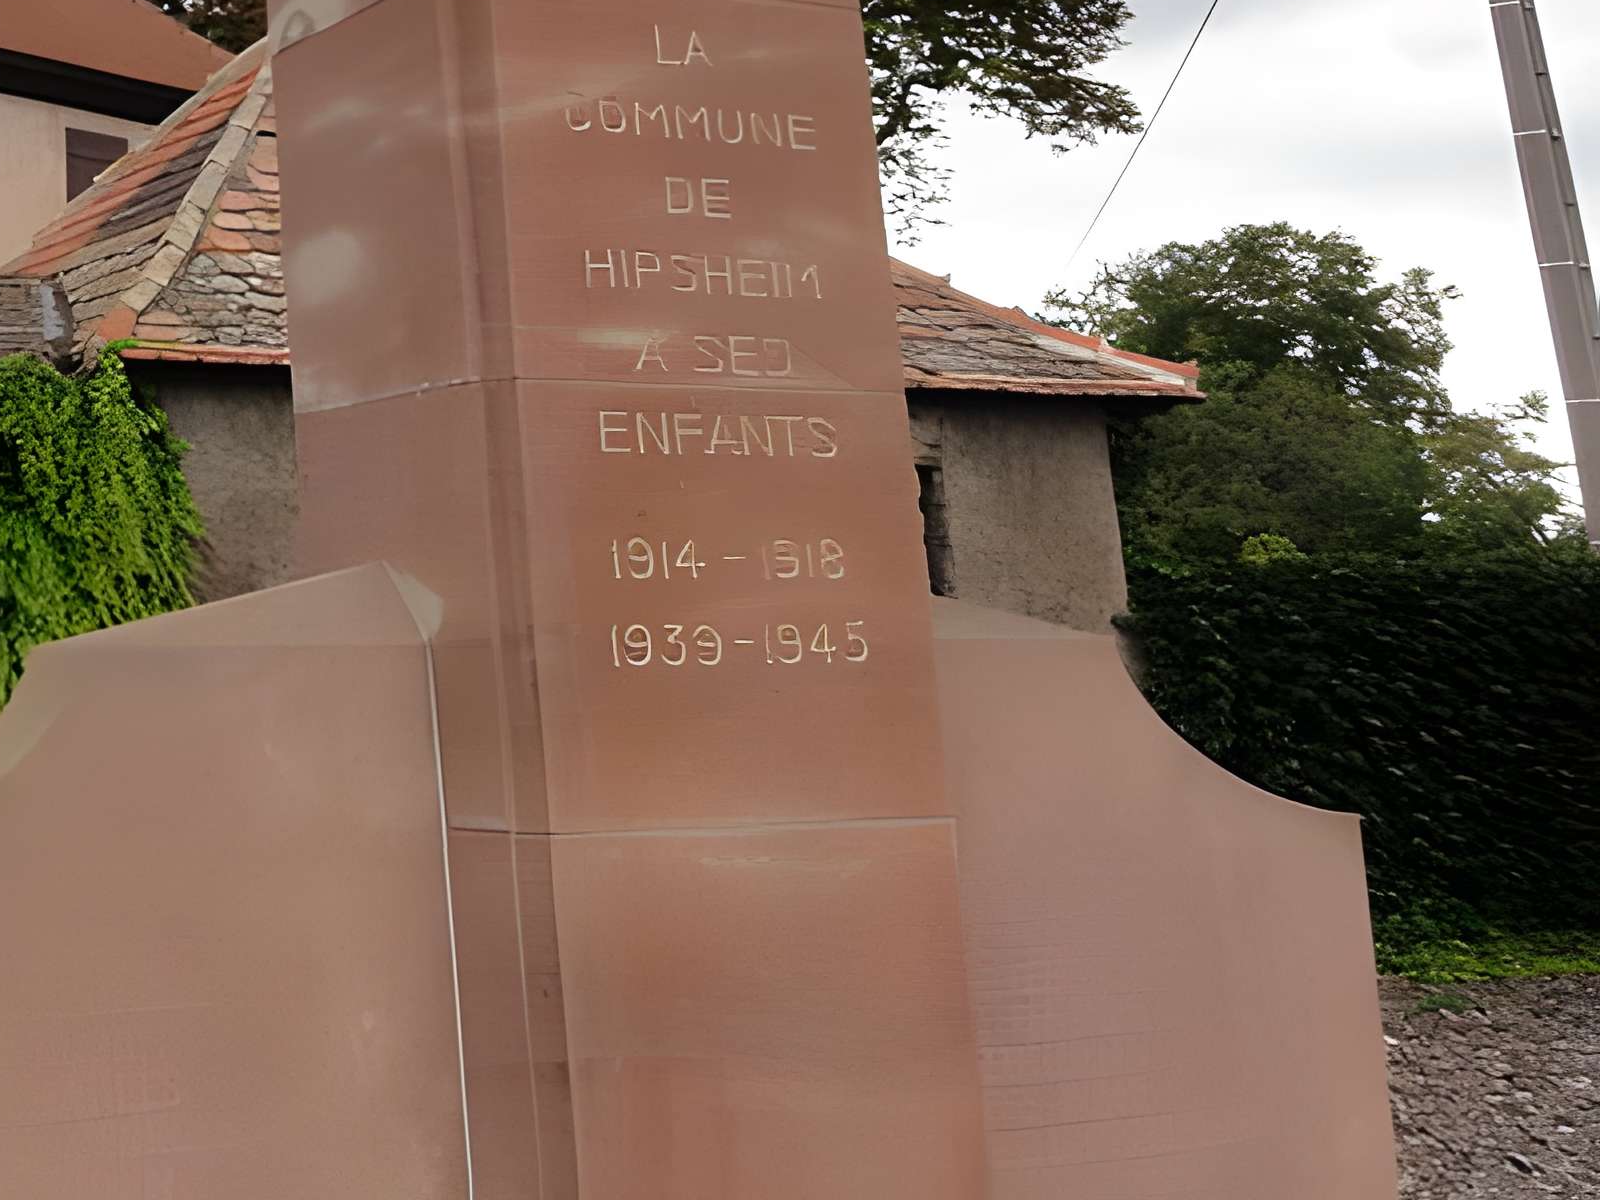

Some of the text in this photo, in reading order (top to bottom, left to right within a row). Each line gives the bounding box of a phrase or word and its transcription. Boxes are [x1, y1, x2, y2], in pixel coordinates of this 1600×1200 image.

[653, 23, 713, 67] LA
[564, 92, 817, 151] COMMUNE
[664, 176, 732, 219] DE
[599, 410, 838, 459] ENFANTS
